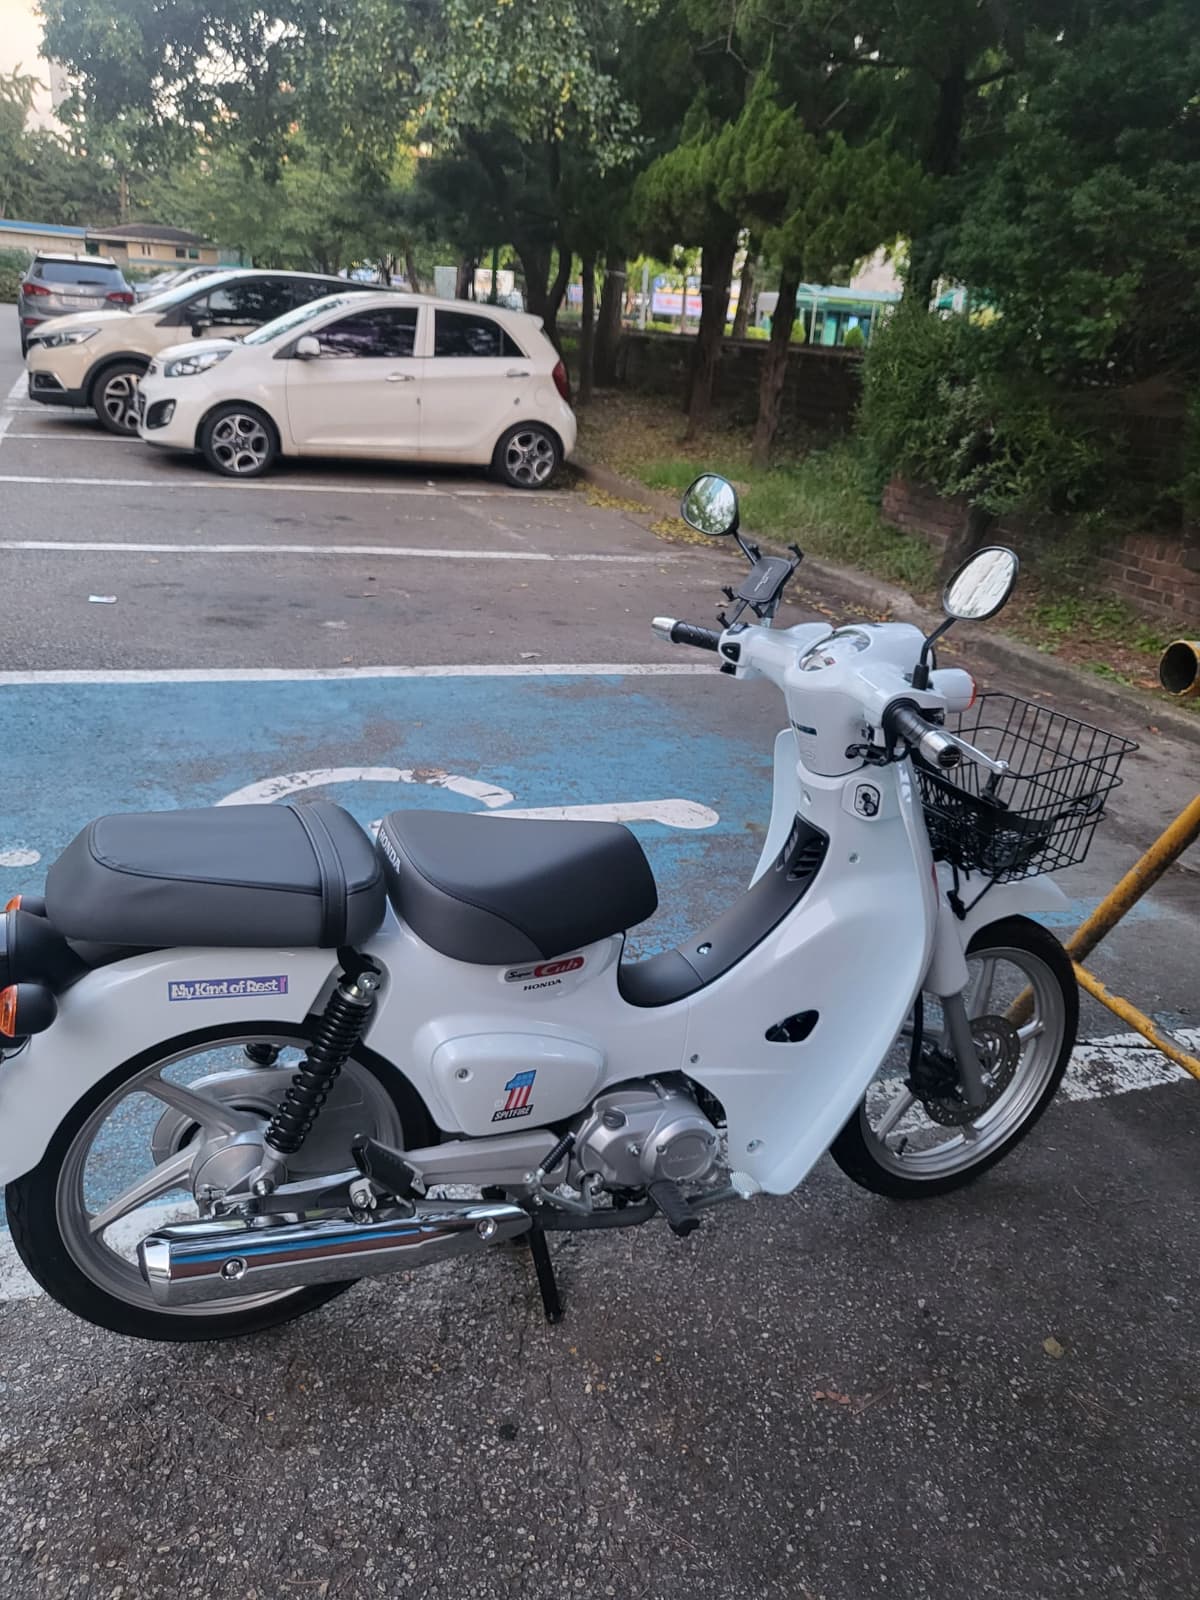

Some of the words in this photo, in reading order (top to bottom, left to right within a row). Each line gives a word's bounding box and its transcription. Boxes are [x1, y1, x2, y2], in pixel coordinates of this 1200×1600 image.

[379, 827, 401, 874] HONDA
[171, 983, 194, 999] My
[195, 982, 227, 996] Kind
[229, 980, 246, 993] of
[246, 979, 279, 993] Rest
[523, 979, 562, 991] HONDA
[494, 1106, 531, 1120] SPITFIRE
